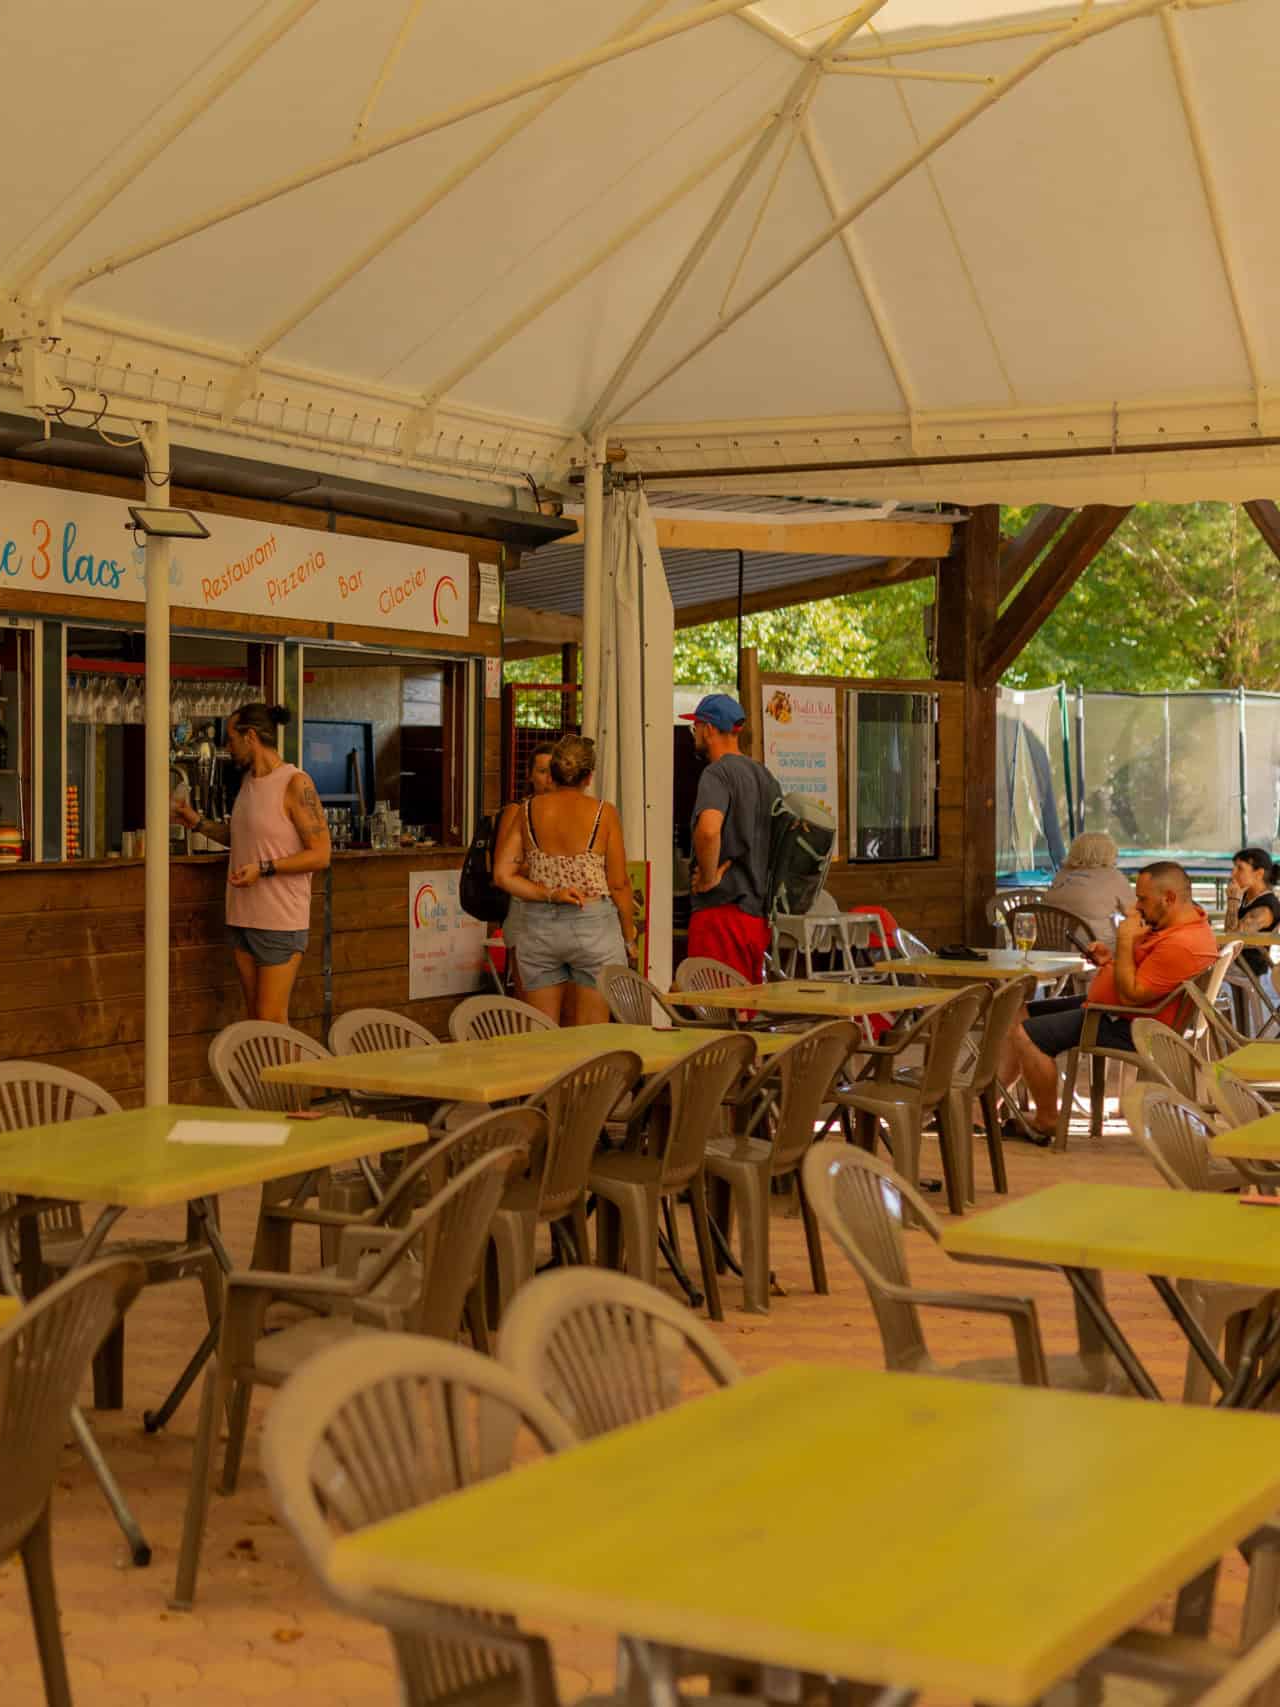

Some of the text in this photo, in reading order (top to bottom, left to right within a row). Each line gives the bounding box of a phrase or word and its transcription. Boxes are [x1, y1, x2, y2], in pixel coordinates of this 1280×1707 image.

[31, 519, 52, 581] 3
[61, 521, 126, 589] lacs
[200, 532, 280, 605] Restaurant
[265, 550, 328, 606] Pizzeria
[336, 569, 365, 600] Bar
[376, 566, 429, 616] Glacier
